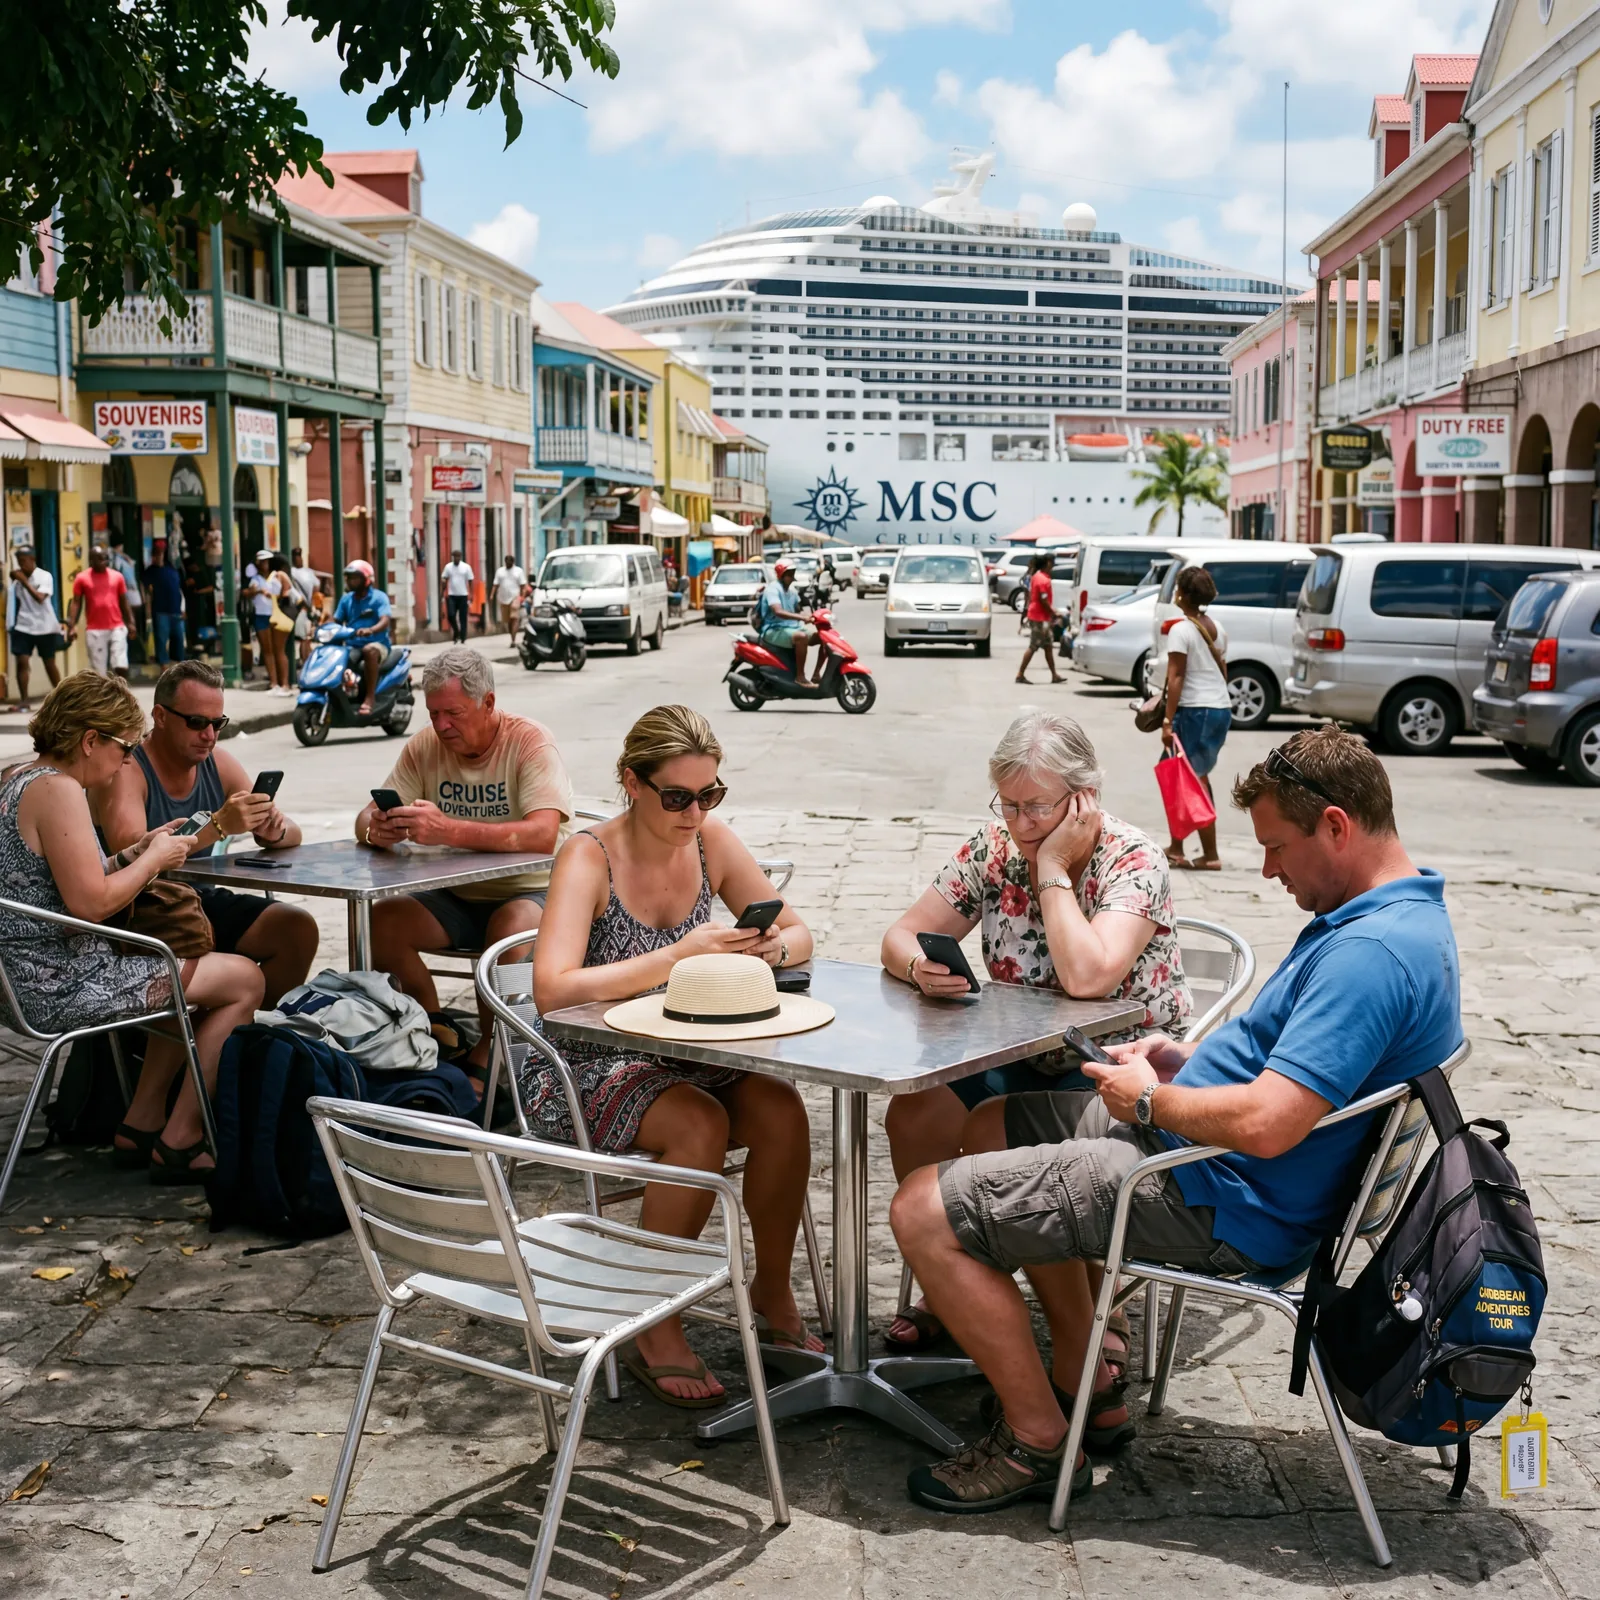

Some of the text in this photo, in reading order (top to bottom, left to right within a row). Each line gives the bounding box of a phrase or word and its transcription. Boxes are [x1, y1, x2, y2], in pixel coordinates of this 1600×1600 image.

[98, 405, 203, 426] SOUVENIRS
[1422, 418, 1505, 434] DUTY FREE
[876, 480, 998, 522] MSC
[875, 533, 997, 545] CRUISES
[439, 780, 507, 803] CRUISE
[437, 800, 510, 817] ADVENTURES
[1489, 1317, 1513, 1330] TOUR
